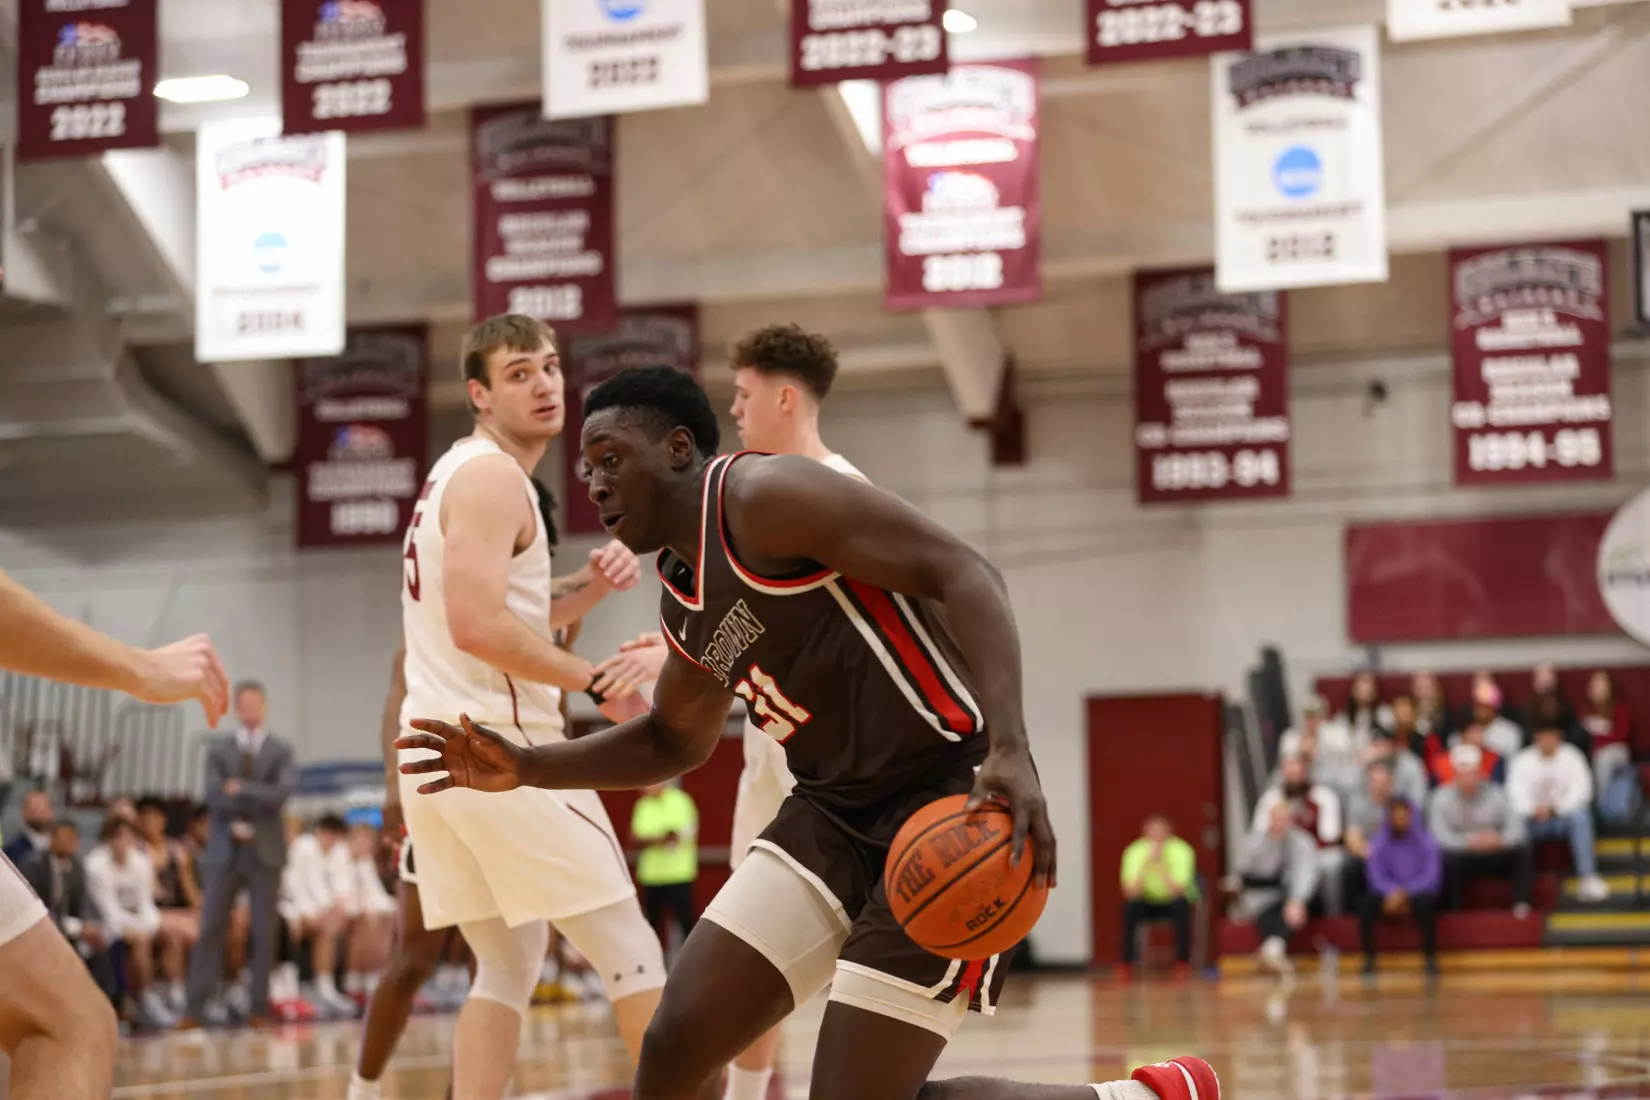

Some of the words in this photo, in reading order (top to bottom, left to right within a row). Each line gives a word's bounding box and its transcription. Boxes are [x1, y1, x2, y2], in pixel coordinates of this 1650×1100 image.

[800, 25, 940, 71] 2022-23
[50, 101, 126, 141] 2022
[312, 78, 393, 119] 2022
[701, 598, 766, 688] BROWN
[733, 662, 813, 744] 31
[895, 849, 936, 903] THE
[965, 895, 1007, 932] ROCK
